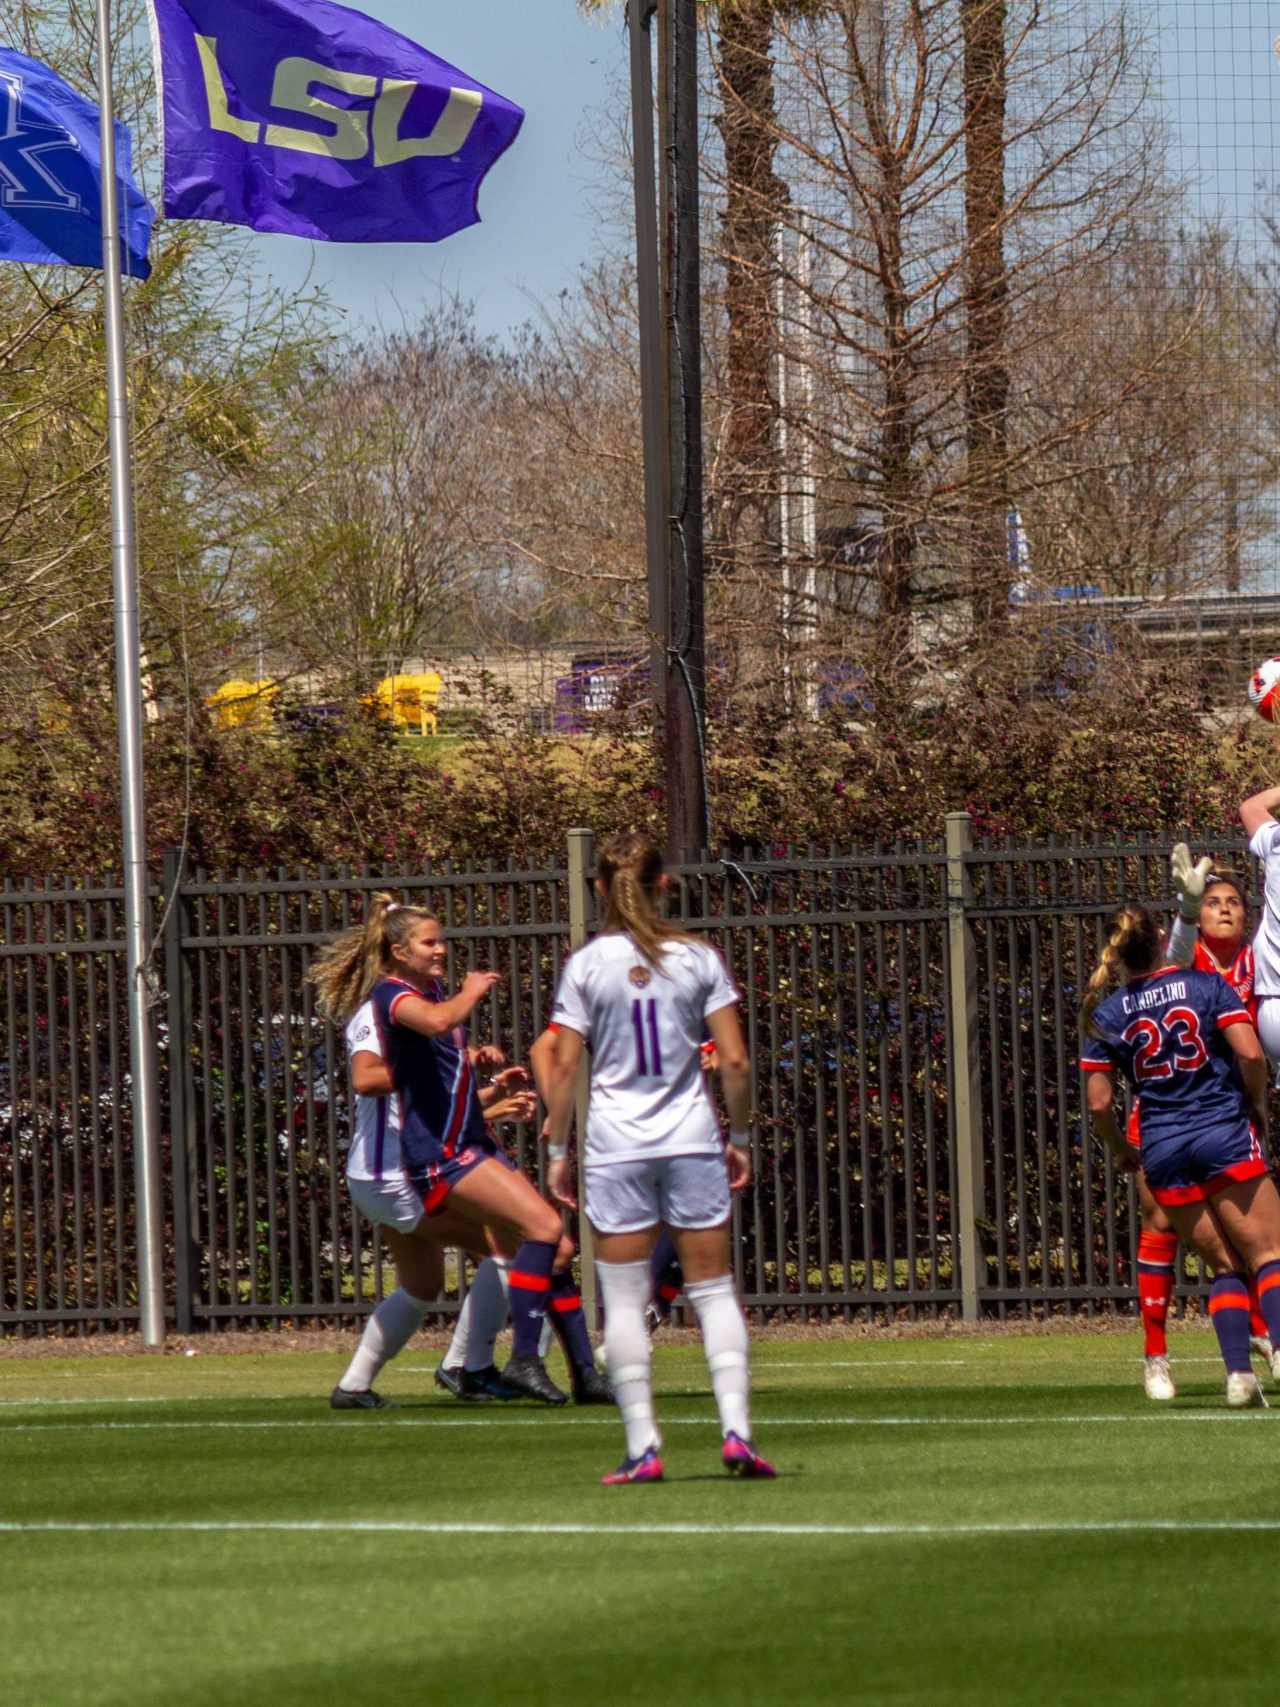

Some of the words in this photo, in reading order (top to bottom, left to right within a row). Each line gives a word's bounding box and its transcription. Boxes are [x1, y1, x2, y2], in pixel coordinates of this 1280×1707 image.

[194, 32, 483, 168] LSU
[631, 998, 663, 1077] 11
[1121, 1006, 1208, 1082] 23
